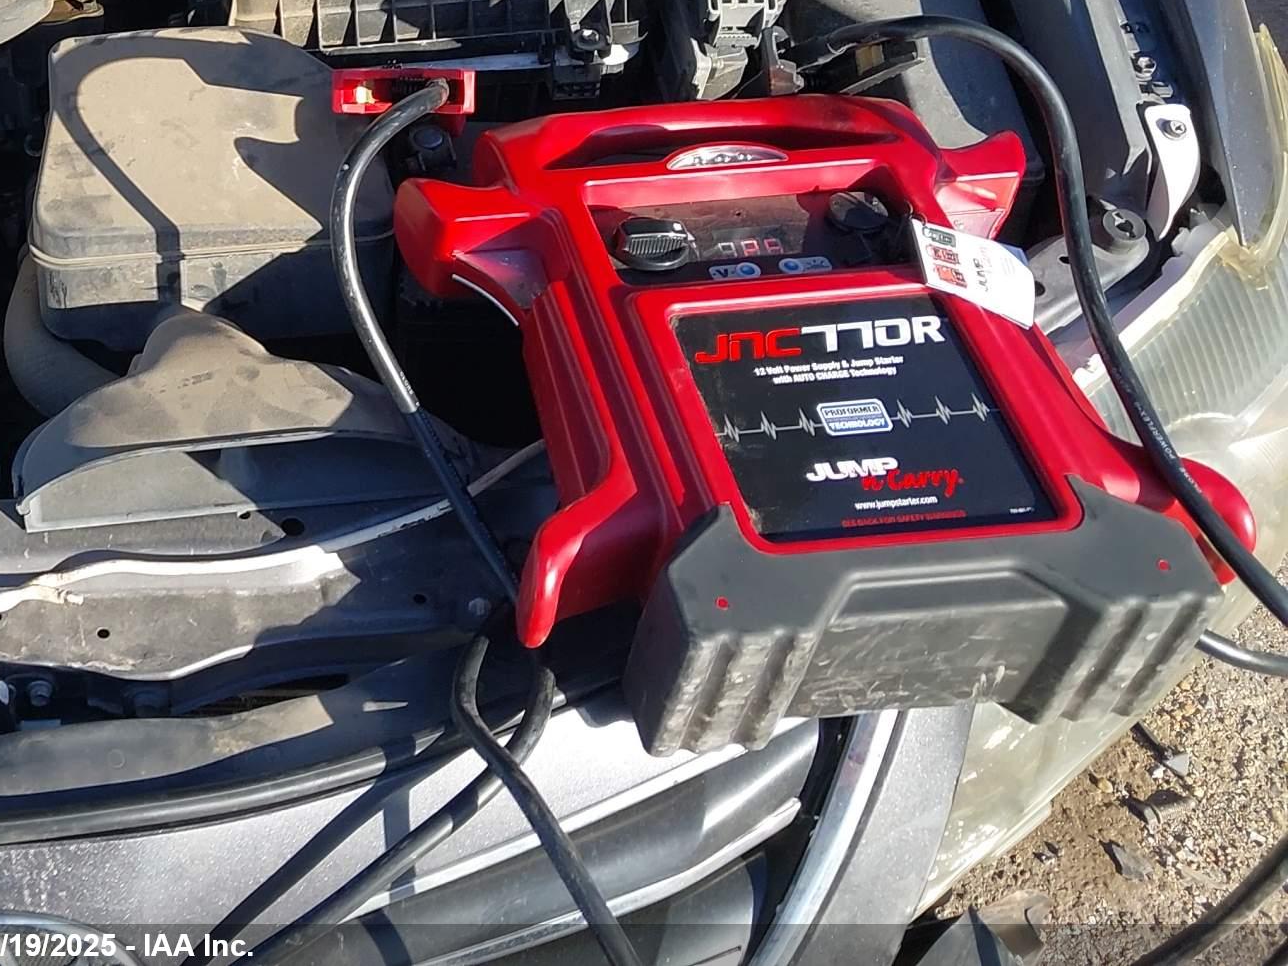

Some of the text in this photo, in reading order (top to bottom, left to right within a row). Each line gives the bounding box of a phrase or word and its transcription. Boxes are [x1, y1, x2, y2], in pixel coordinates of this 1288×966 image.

[753, 355, 904, 376] 12 Volt Power Supply & Jump Starter
[772, 366, 897, 384] with AUTO CHARGE Technology
[824, 405, 880, 417] PROFORMER
[829, 417, 886, 430] TECHNOLOGY
[806, 456, 899, 482] JUMP
[854, 495, 939, 510] www.jumpstarter.com
